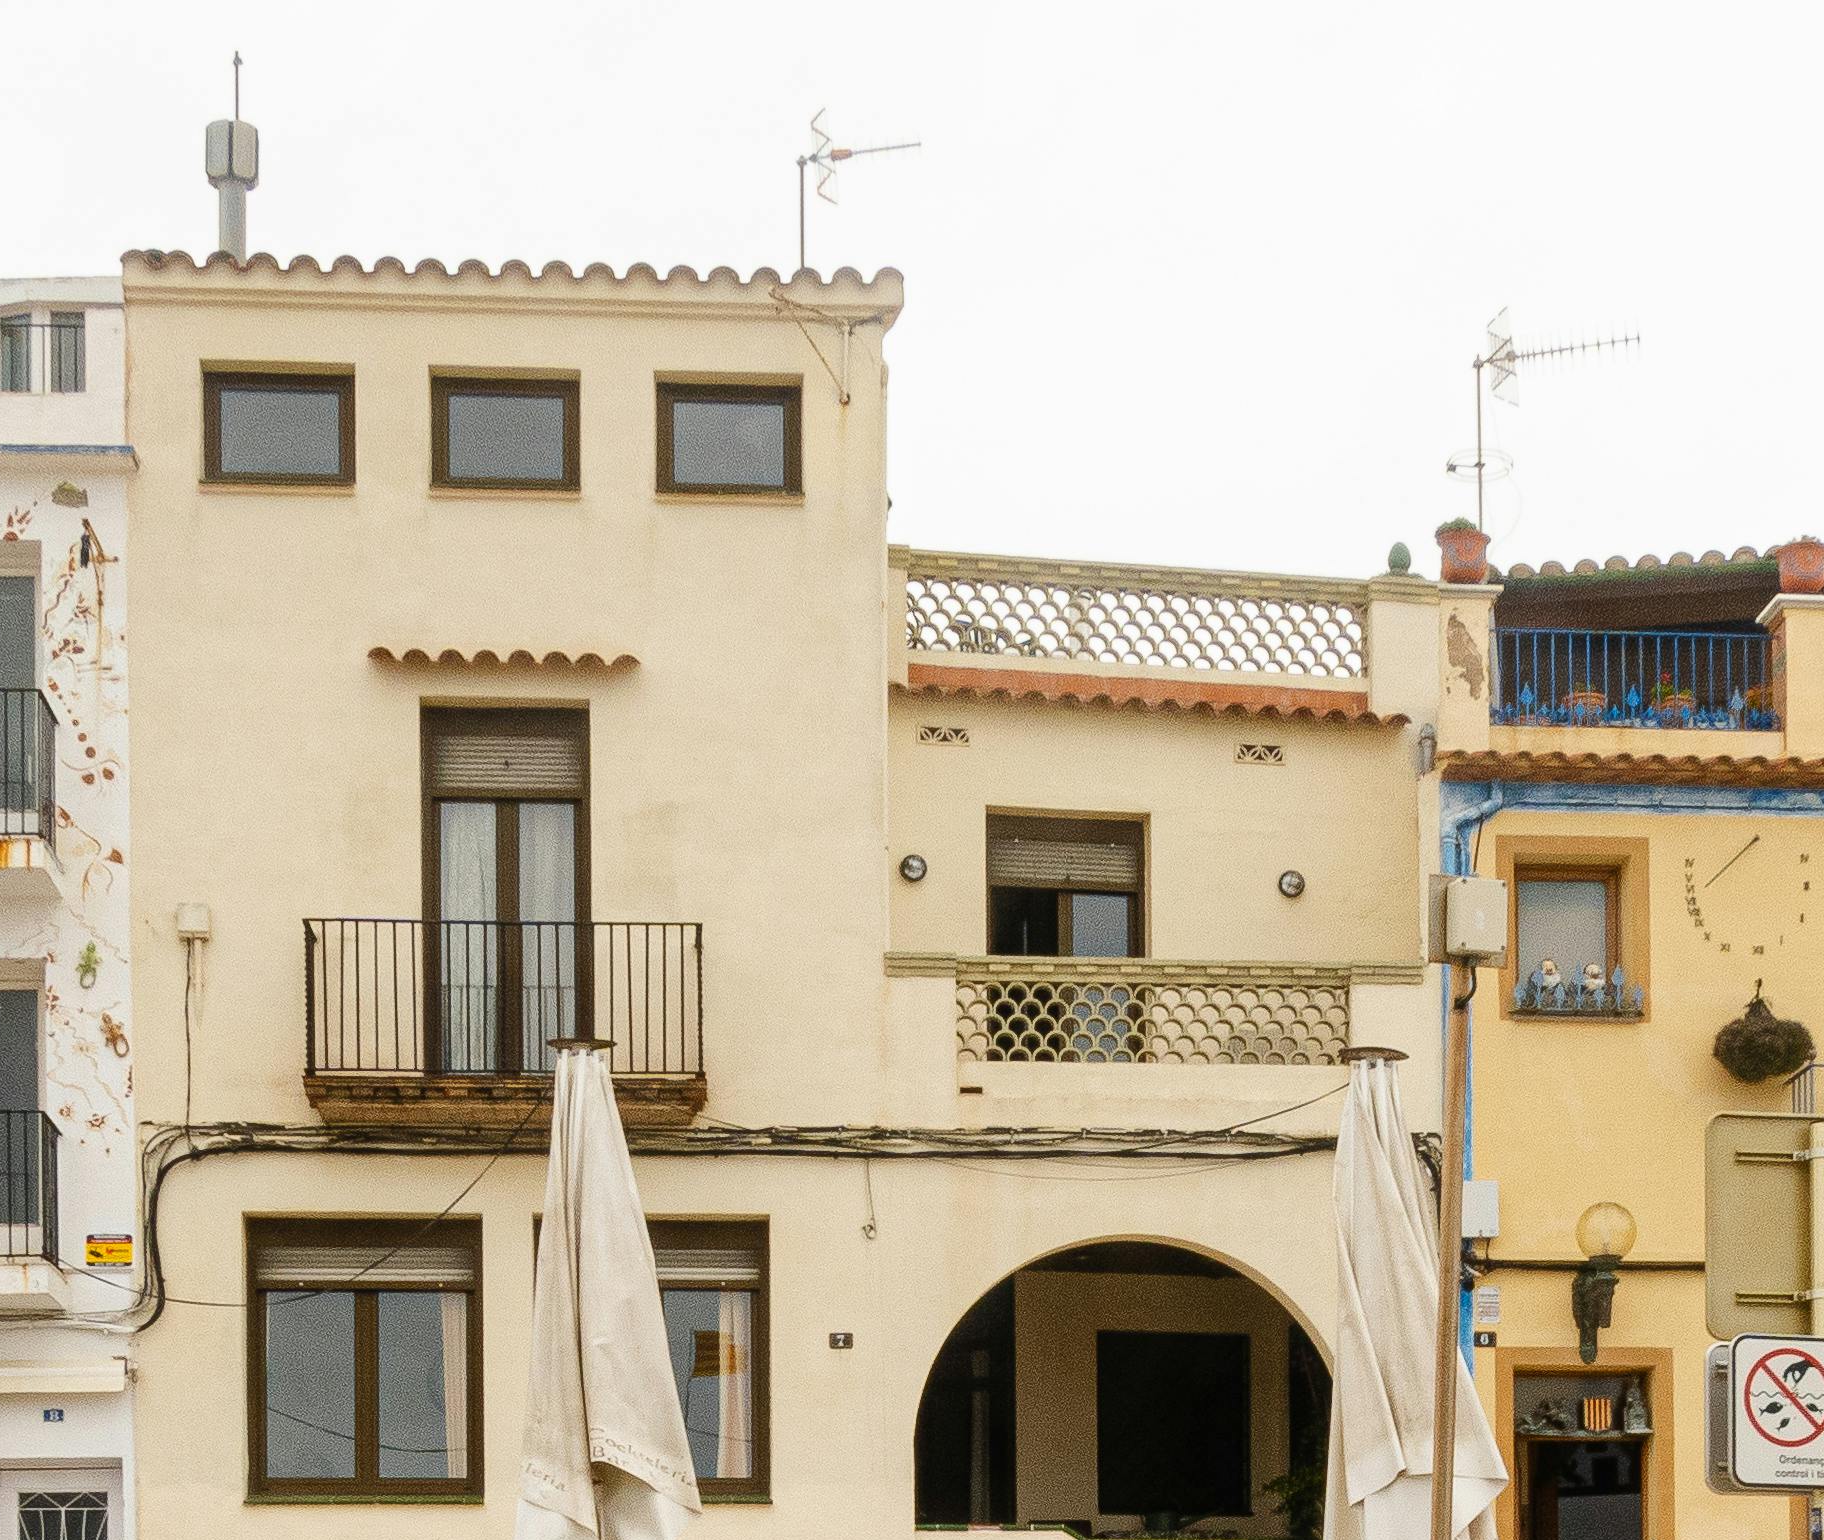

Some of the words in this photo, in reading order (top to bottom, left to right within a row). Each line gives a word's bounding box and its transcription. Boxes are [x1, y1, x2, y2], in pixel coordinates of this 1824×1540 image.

[836, 1334, 845, 1347] 7
[1776, 1469, 1809, 1478] control
[1811, 1469, 1815, 1478] i
